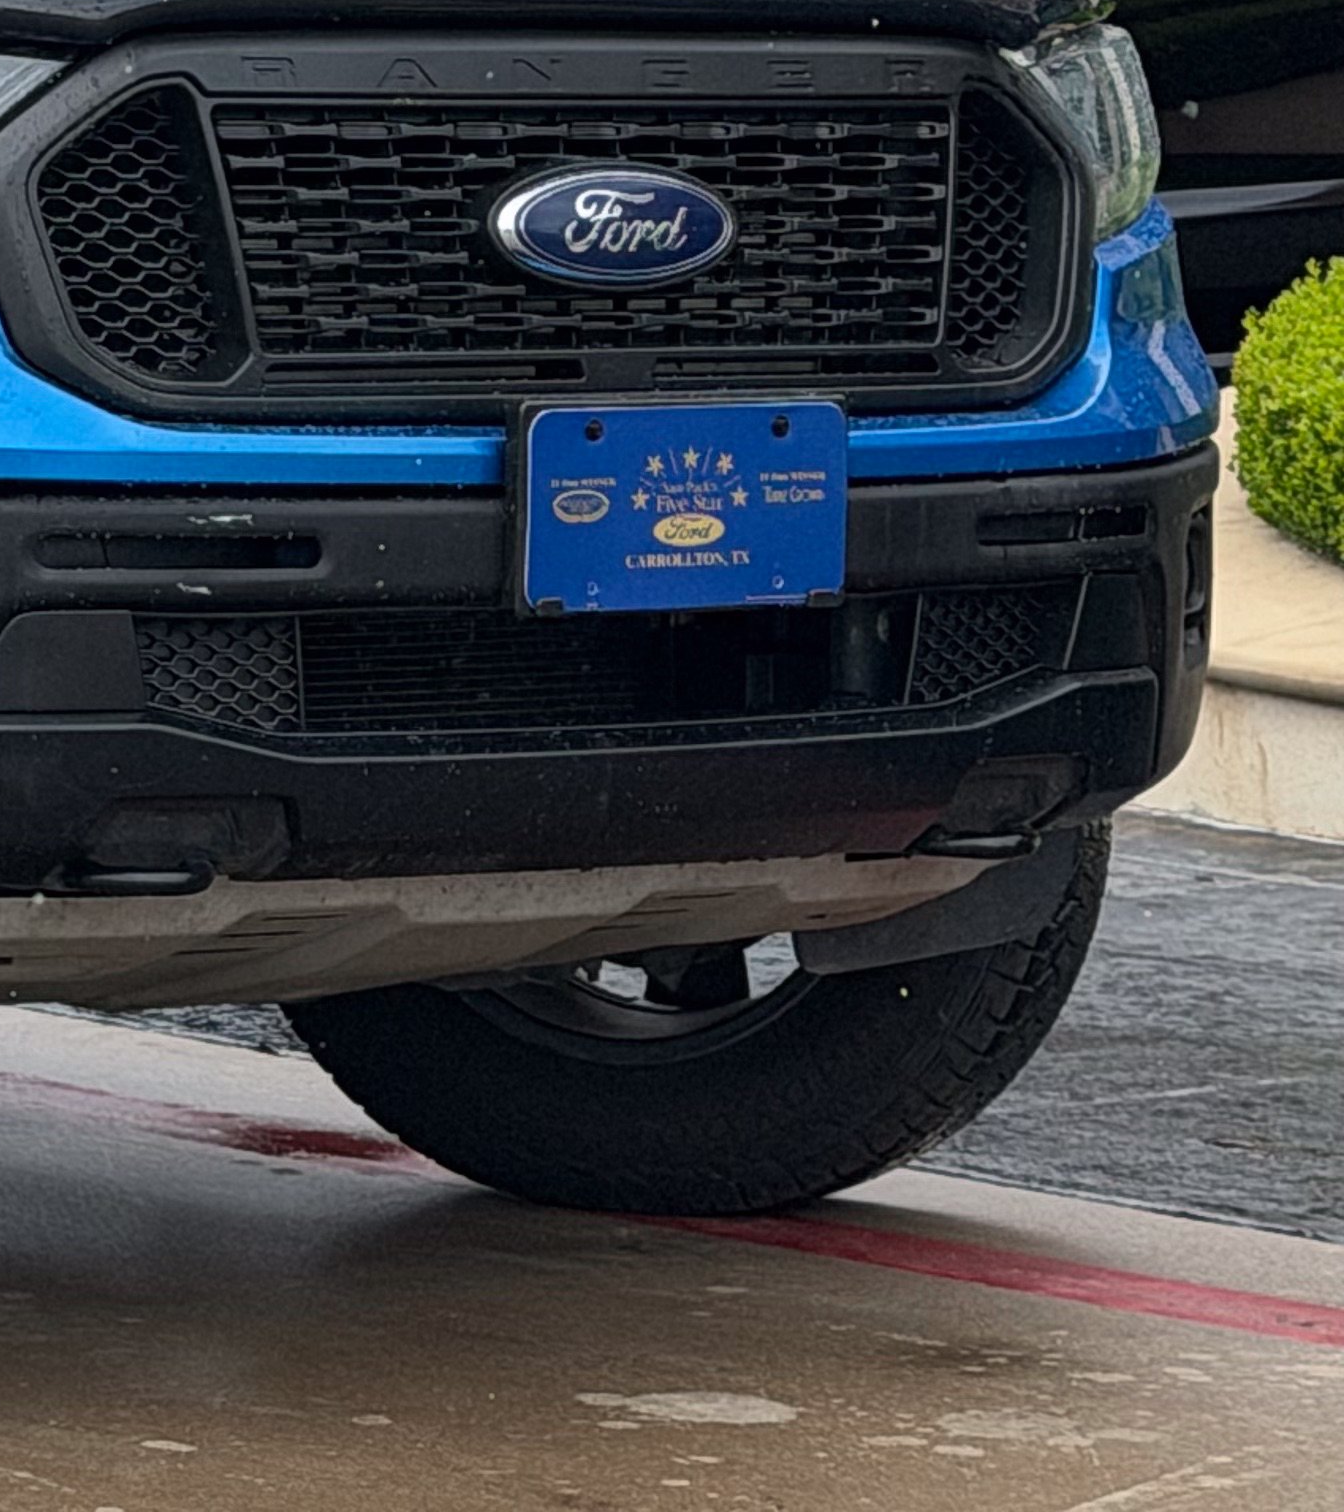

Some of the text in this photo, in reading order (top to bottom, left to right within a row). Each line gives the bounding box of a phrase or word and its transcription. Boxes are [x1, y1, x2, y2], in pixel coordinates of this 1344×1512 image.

[564, 189, 689, 254] Ford
[663, 516, 714, 541] Ford
[731, 549, 751, 566] TX
